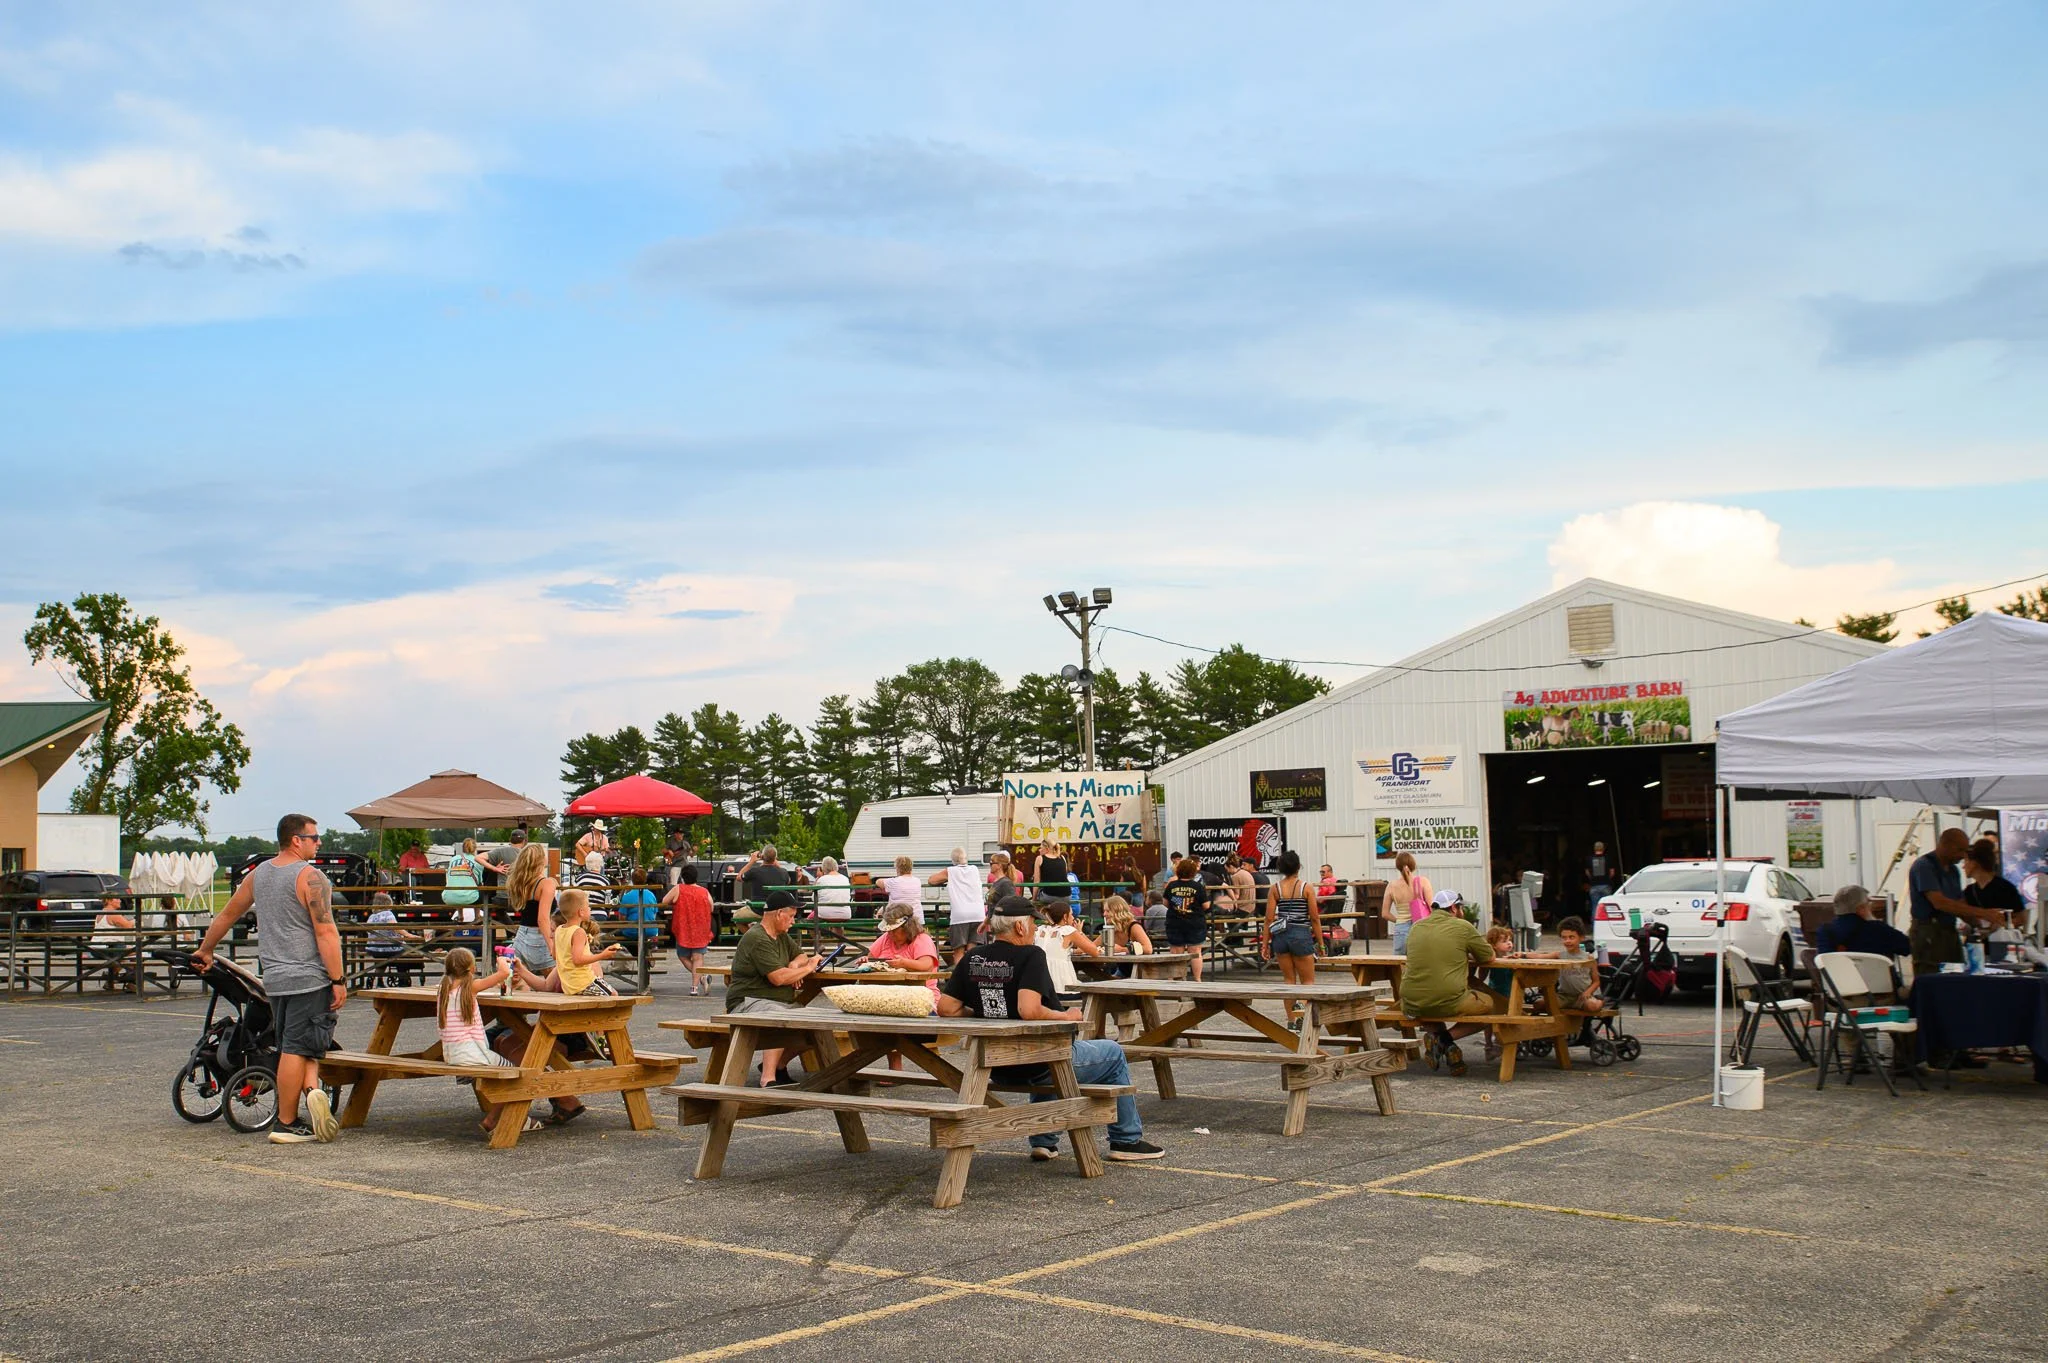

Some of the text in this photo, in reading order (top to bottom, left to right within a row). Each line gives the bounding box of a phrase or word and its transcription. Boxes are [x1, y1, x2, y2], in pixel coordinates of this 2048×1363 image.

[1514, 681, 1683, 707] Ag ADVENTURE BARN
[1004, 777, 1142, 799] North Miami
[1255, 783, 1322, 799] MUSSELMAN
[1381, 779, 1431, 787] TRANSPORT
[1052, 800, 1095, 819] FFA
[1012, 820, 1142, 840] Corn Maze
[1393, 817, 1456, 827] MIAMI COUNTY
[1189, 828, 1243, 839] NORTH MIAMI
[1394, 825, 1479, 841] SOIL & WATER
[1193, 841, 1240, 852] COMMUNITY
[1394, 839, 1479, 850] CONSERVATION DISTRICT
